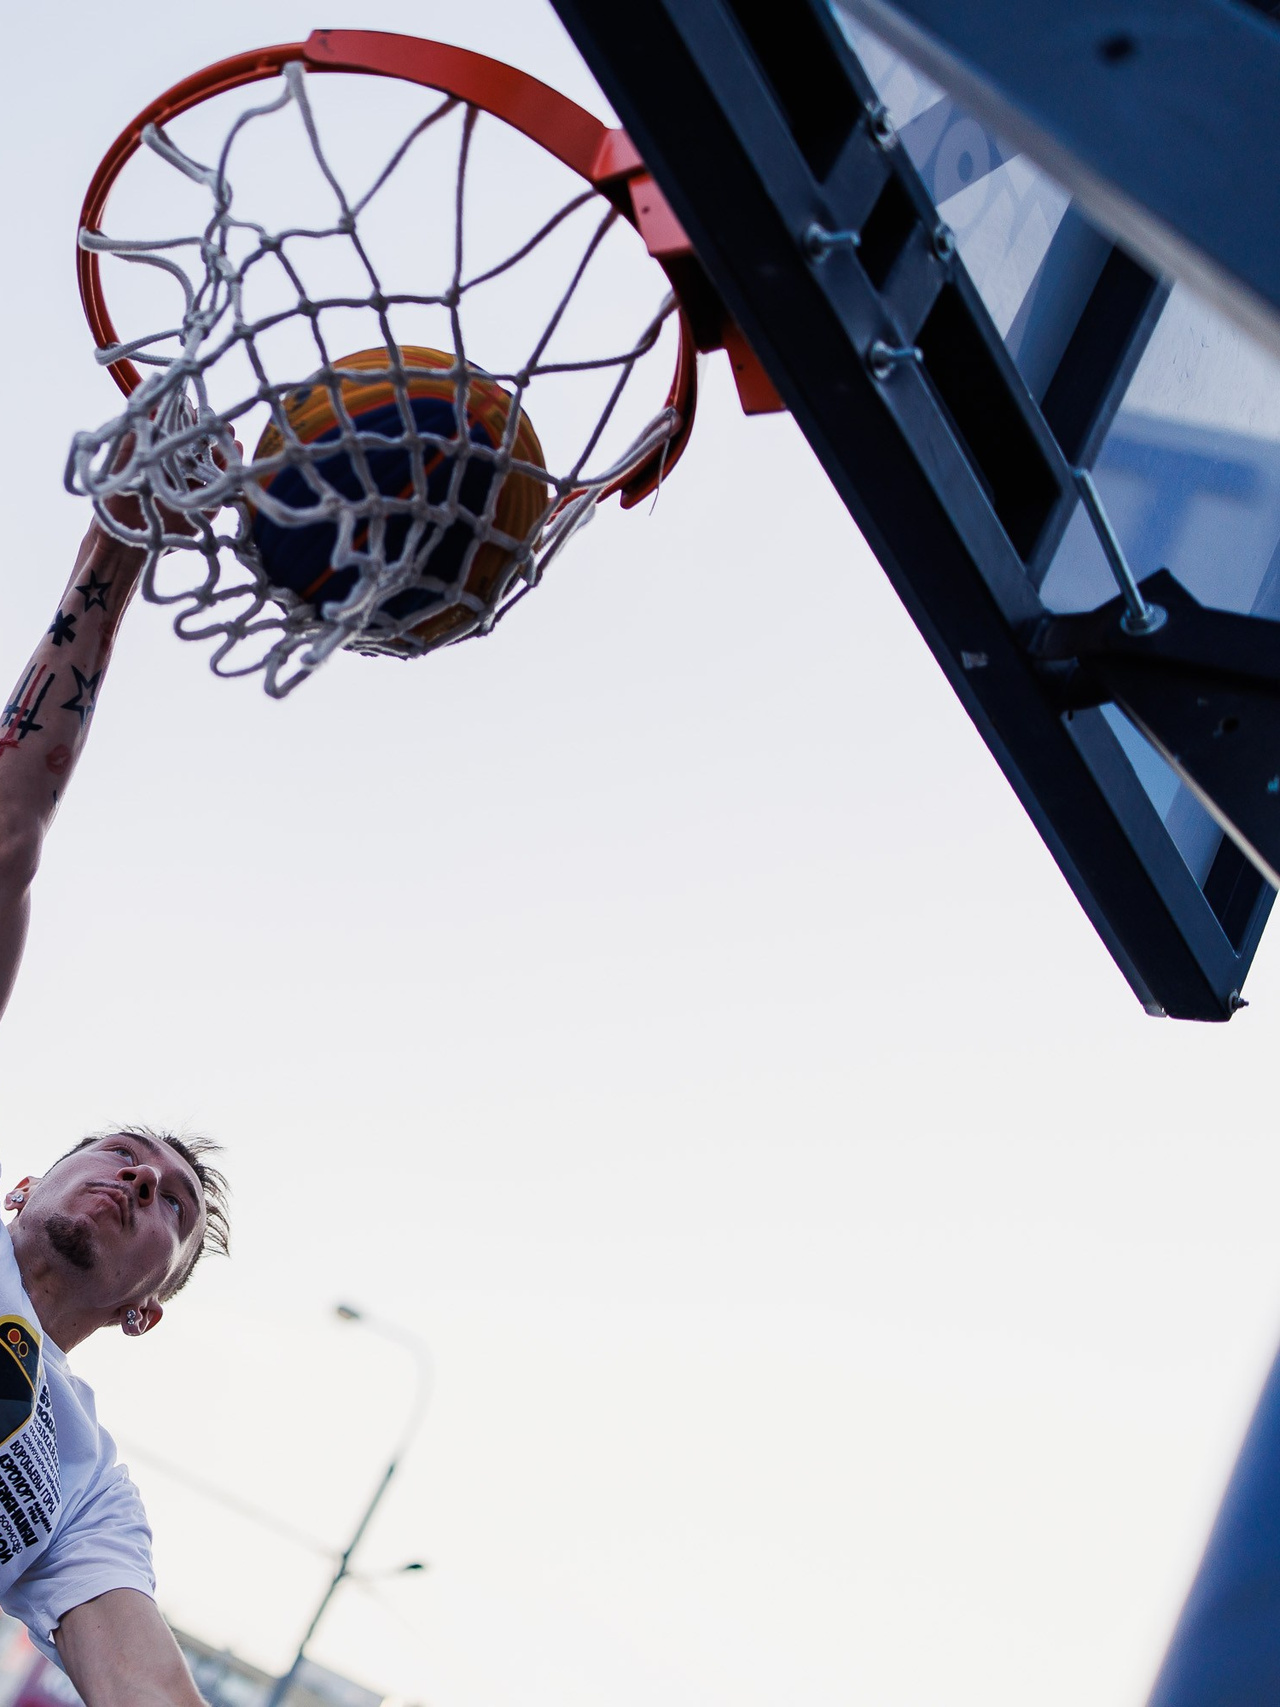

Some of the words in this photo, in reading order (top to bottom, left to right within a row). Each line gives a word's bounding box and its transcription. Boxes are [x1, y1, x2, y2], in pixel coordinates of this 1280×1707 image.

[20, 1431, 48, 1474] КОММУНАРКА
[9, 1439, 46, 1493] ВОРОБЬЕВЫ
[39, 1487, 57, 1516] ГОРЫ
[26, 1505, 41, 1526] РОЩА
[32, 1500, 53, 1534] МАРЬИНА
